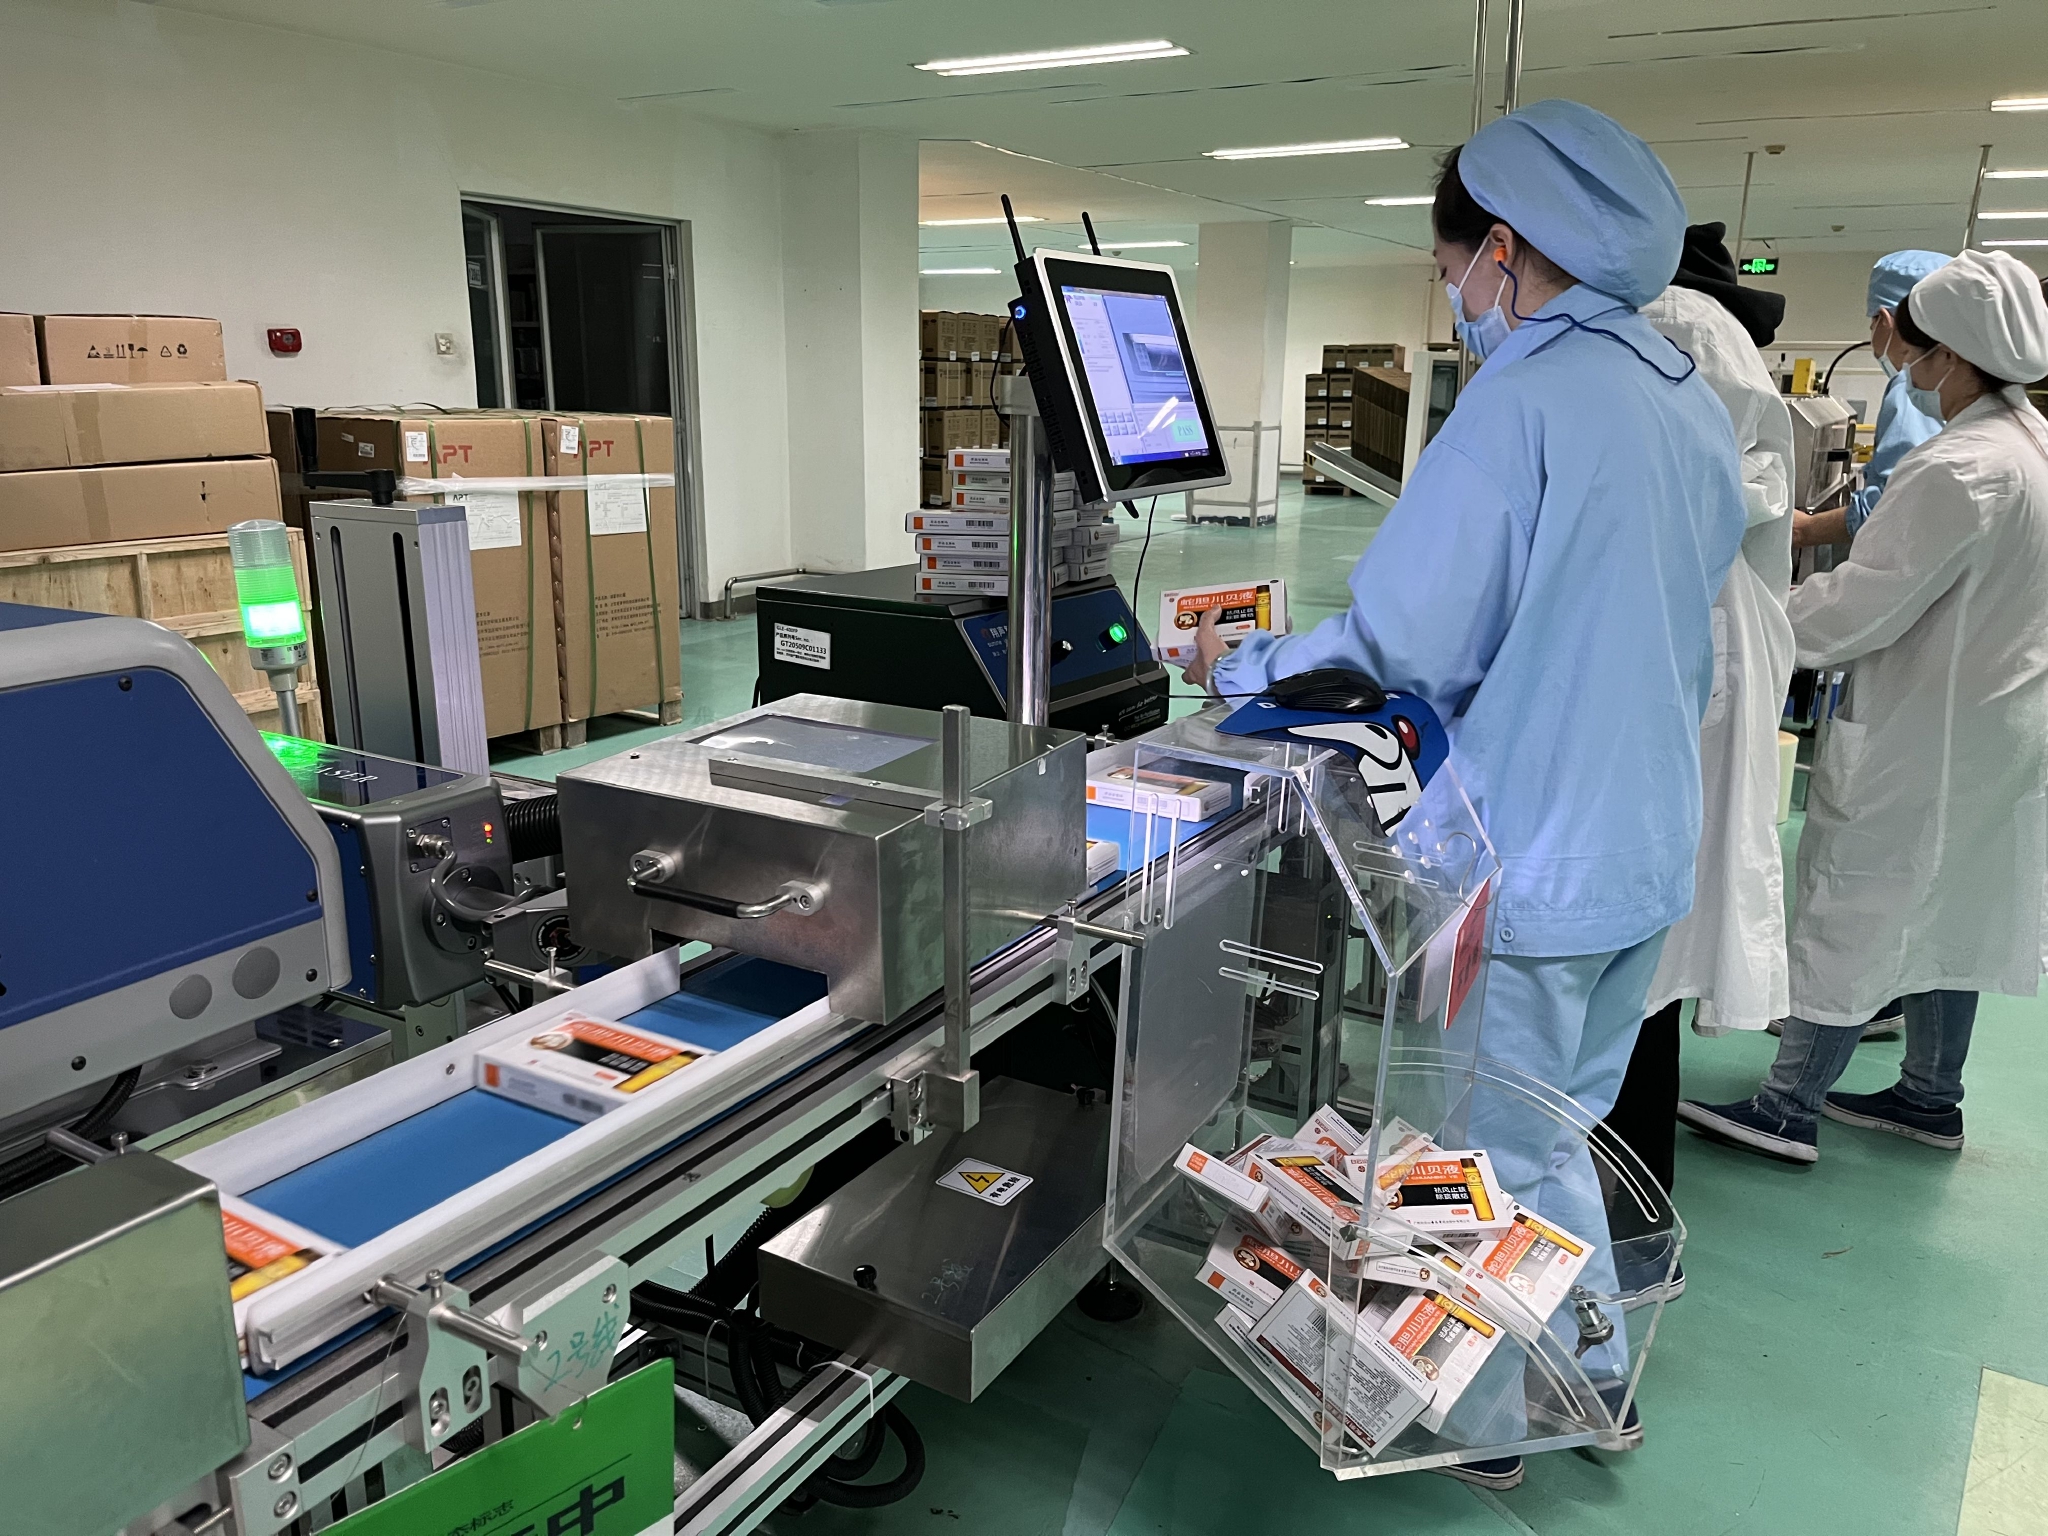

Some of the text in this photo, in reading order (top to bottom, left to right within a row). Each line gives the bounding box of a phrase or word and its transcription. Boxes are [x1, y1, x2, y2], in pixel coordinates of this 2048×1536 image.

[1180, 591, 1254, 606] 蛇胆川贝液
